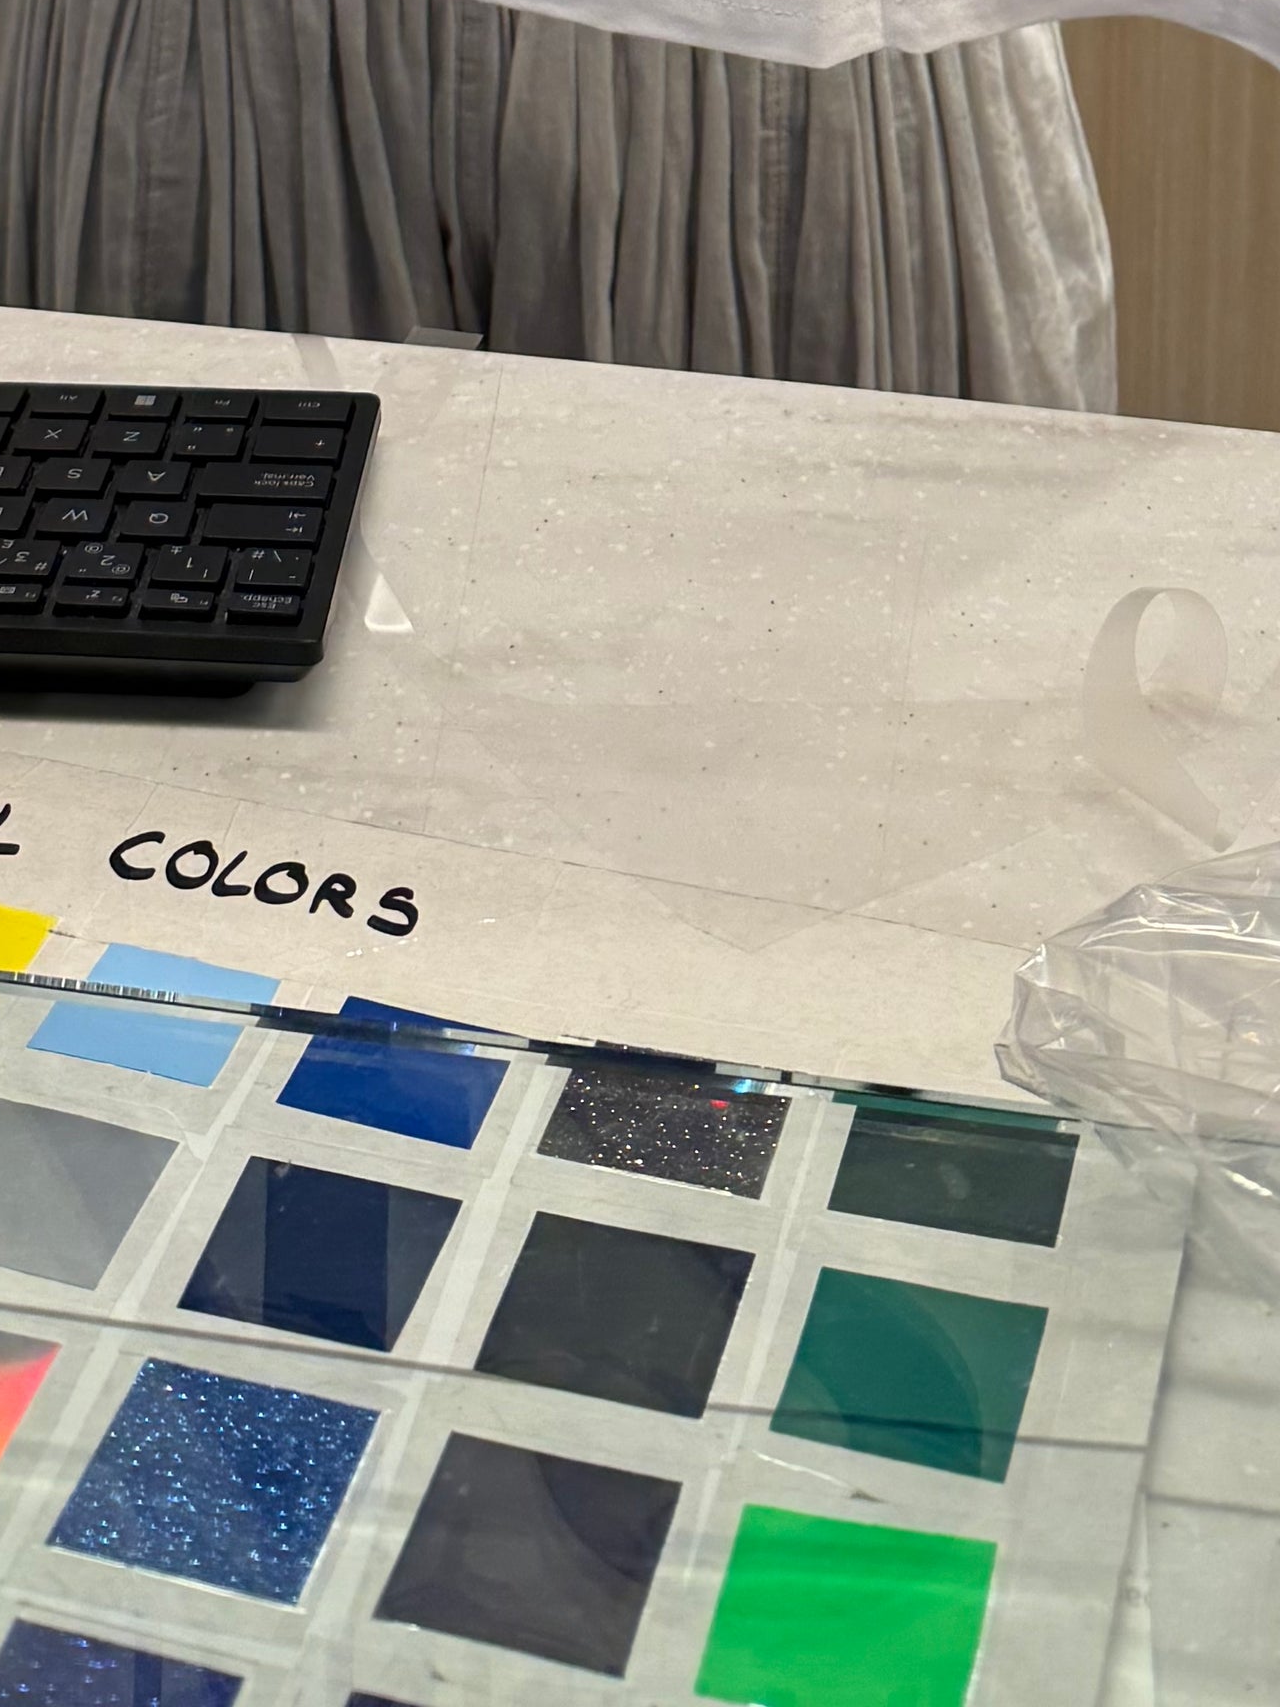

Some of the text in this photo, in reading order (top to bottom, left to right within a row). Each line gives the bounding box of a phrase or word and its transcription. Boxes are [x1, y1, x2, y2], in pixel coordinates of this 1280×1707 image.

[45, 429, 62, 439] X
[124, 432, 139, 441] Z
[68, 469, 82, 478] S
[148, 472, 165, 481] A
[62, 510, 87, 520] W
[149, 513, 168, 523] Q
[108, 830, 419, 937] COLORS
